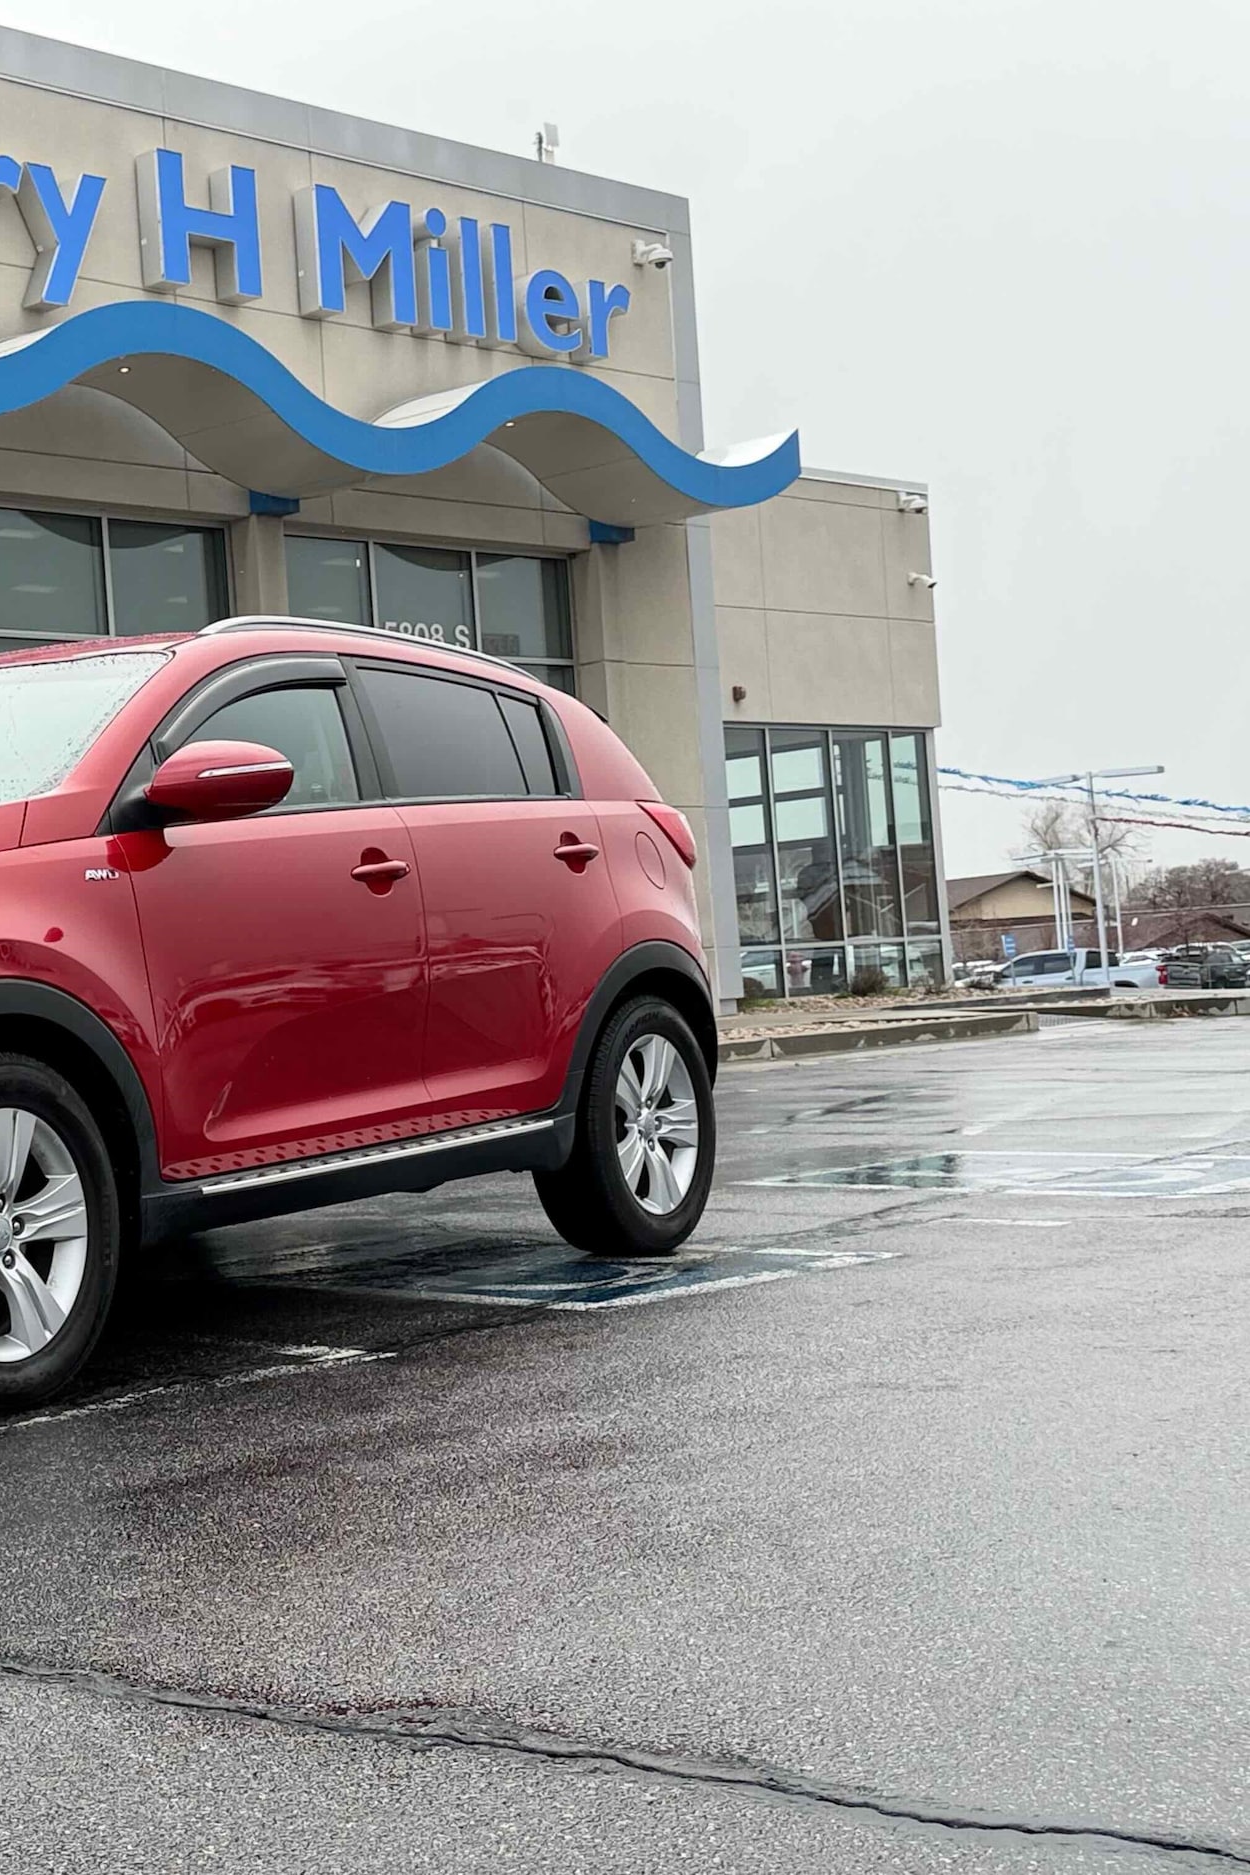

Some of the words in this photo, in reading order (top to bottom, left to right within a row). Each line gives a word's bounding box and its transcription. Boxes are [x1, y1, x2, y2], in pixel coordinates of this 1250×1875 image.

[146, 146, 263, 299] H
[306, 183, 632, 360] Miller
[454, 624, 471, 649] S
[85, 869, 120, 881] AWD
